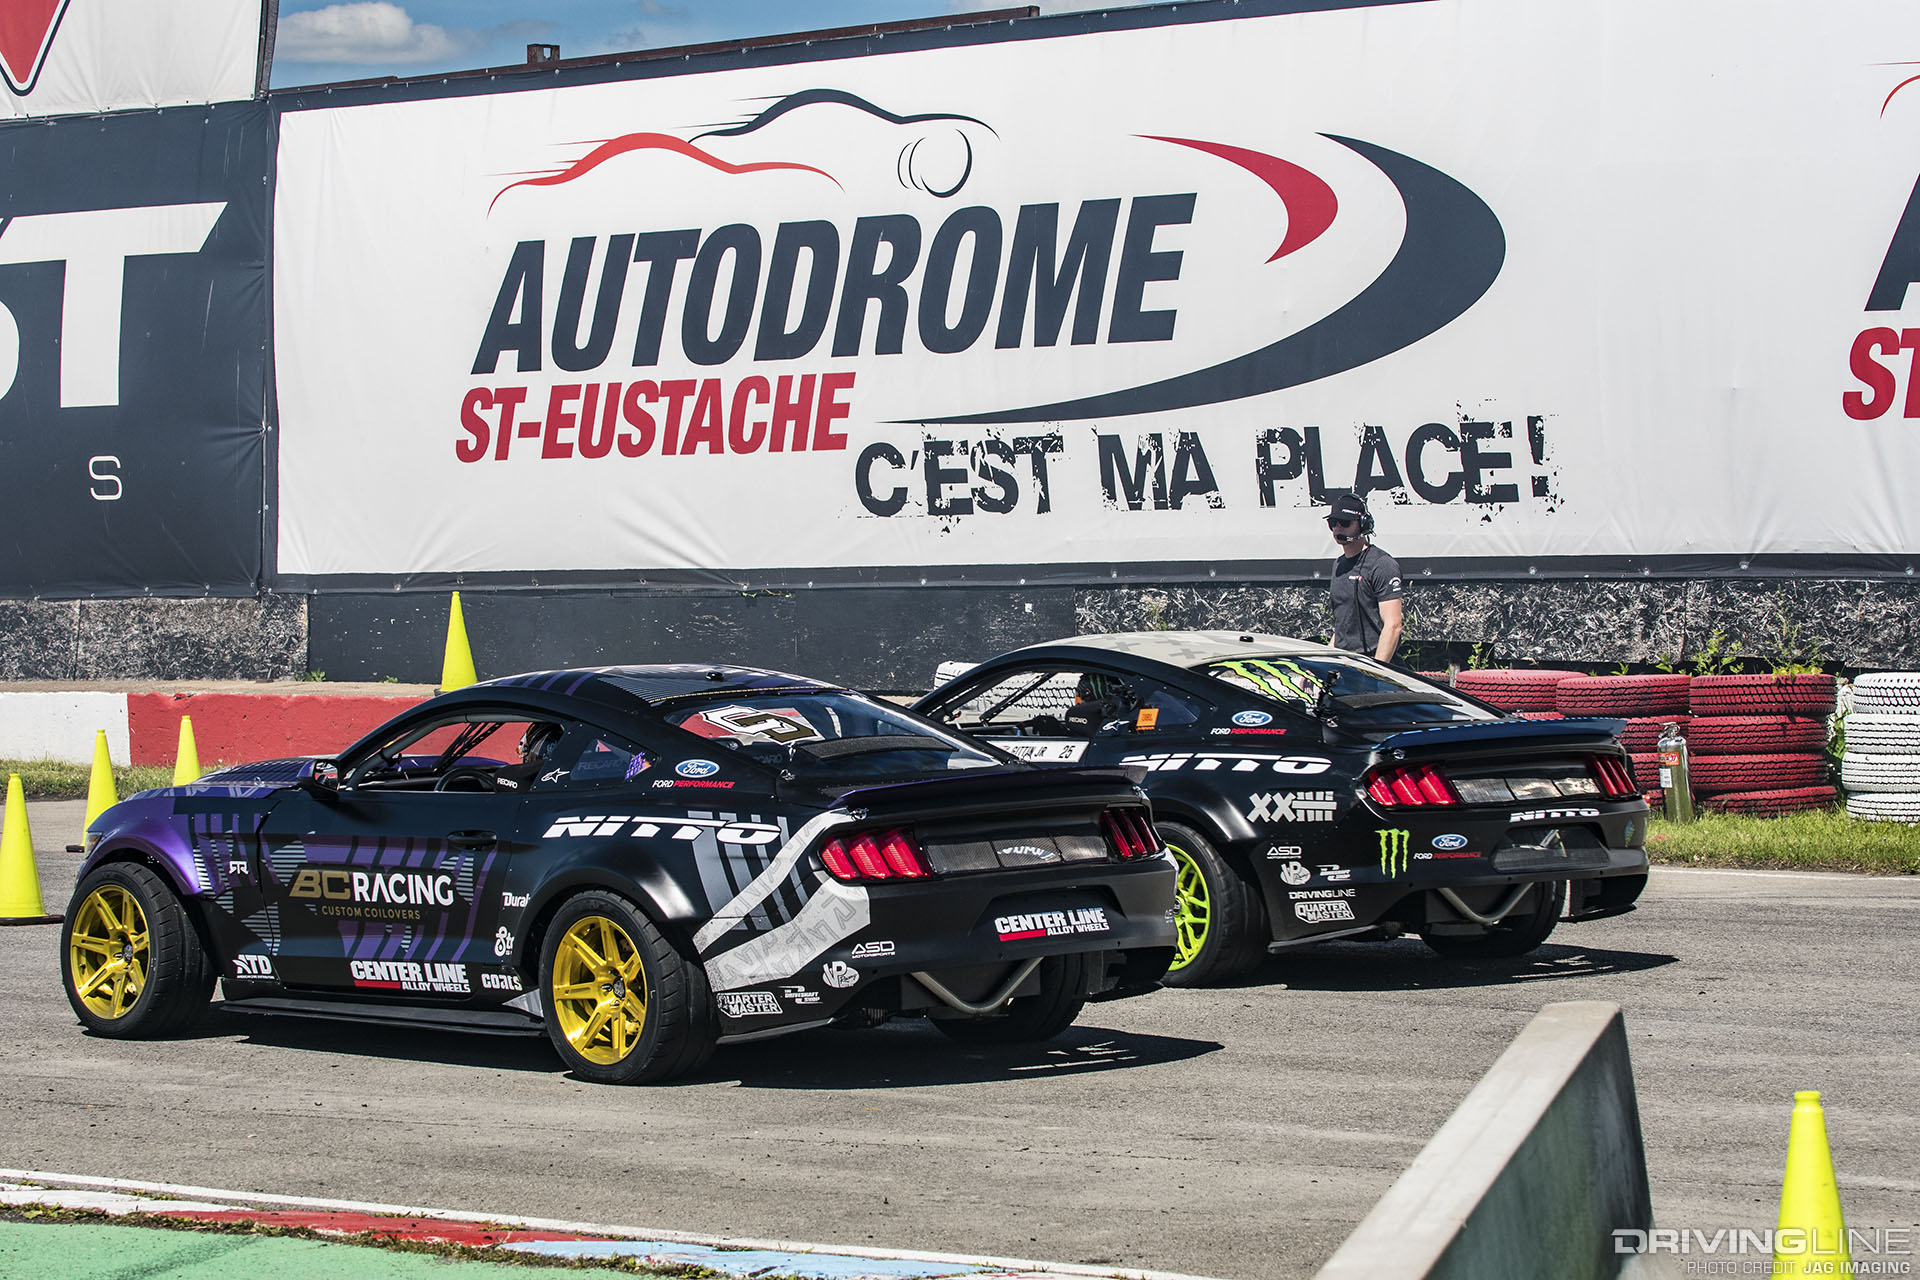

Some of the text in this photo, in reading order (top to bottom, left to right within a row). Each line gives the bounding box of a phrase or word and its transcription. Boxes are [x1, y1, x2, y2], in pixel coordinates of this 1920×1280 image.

[471, 193, 1198, 375] AUTODROME
[456, 372, 856, 464] ST-EUSTACHE
[88, 455, 122, 500] S
[855, 432, 1063, 516] C'EST
[1098, 427, 1226, 510] MA
[1058, 745, 1076, 759] 25
[1119, 753, 1332, 774] NITTO
[652, 780, 735, 789] FORD PERFORMANCE
[1509, 808, 1600, 822] NITTO
[542, 816, 781, 845] NITTO
[1267, 846, 1302, 856] ASD
[289, 870, 454, 906] BC RACING
[321, 905, 421, 920] CUSTOM COILOVERS
[1295, 903, 1347, 916] QUARTER
[1307, 911, 1351, 920] MASTER
[994, 907, 1107, 934] CENTER LINE
[1047, 922, 1110, 937] ALLOY WHEELS
[852, 941, 895, 954] ASD
[232, 954, 272, 975] ATD
[350, 960, 470, 984] CENTER LINE
[402, 981, 471, 993] ALLOY WHEELS
[729, 1003, 779, 1014] MASTER
